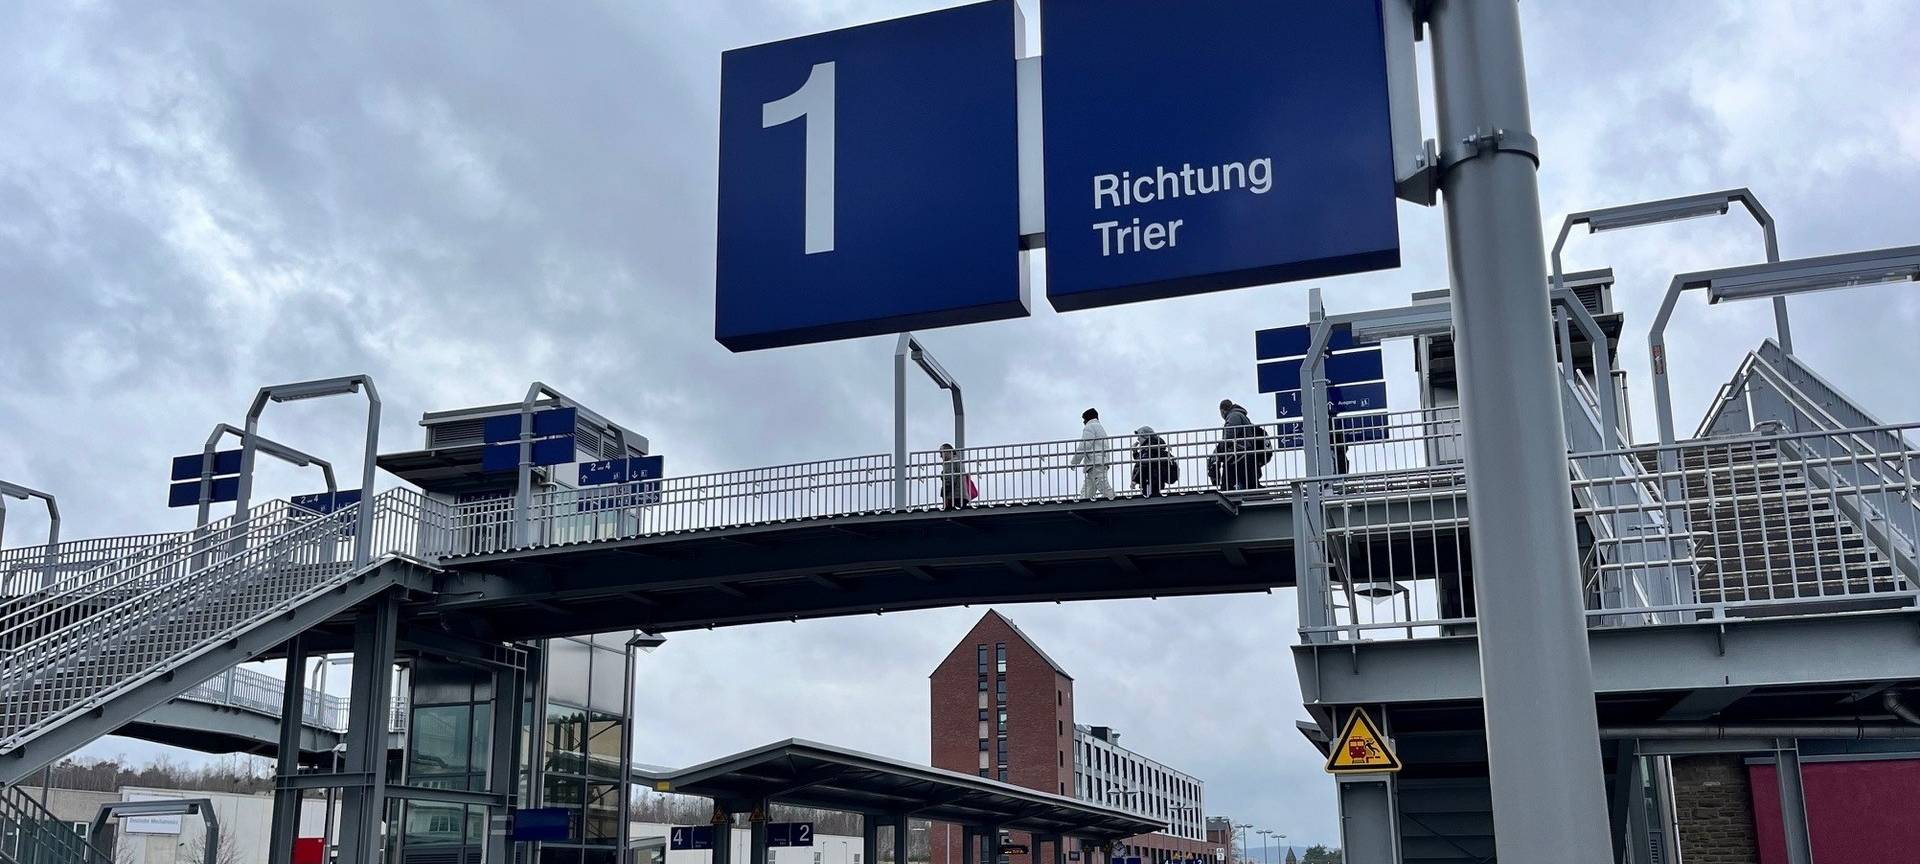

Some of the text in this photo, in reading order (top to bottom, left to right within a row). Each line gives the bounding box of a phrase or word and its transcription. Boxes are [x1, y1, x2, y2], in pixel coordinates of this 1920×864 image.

[762, 61, 835, 254] 1
[1094, 157, 1272, 209] Richtung
[1093, 217, 1183, 256] Trier
[591, 463, 596, 472] 2
[606, 461, 611, 470] 4
[301, 496, 306, 504] 2
[673, 829, 683, 845] 4
[800, 825, 809, 841] 2
